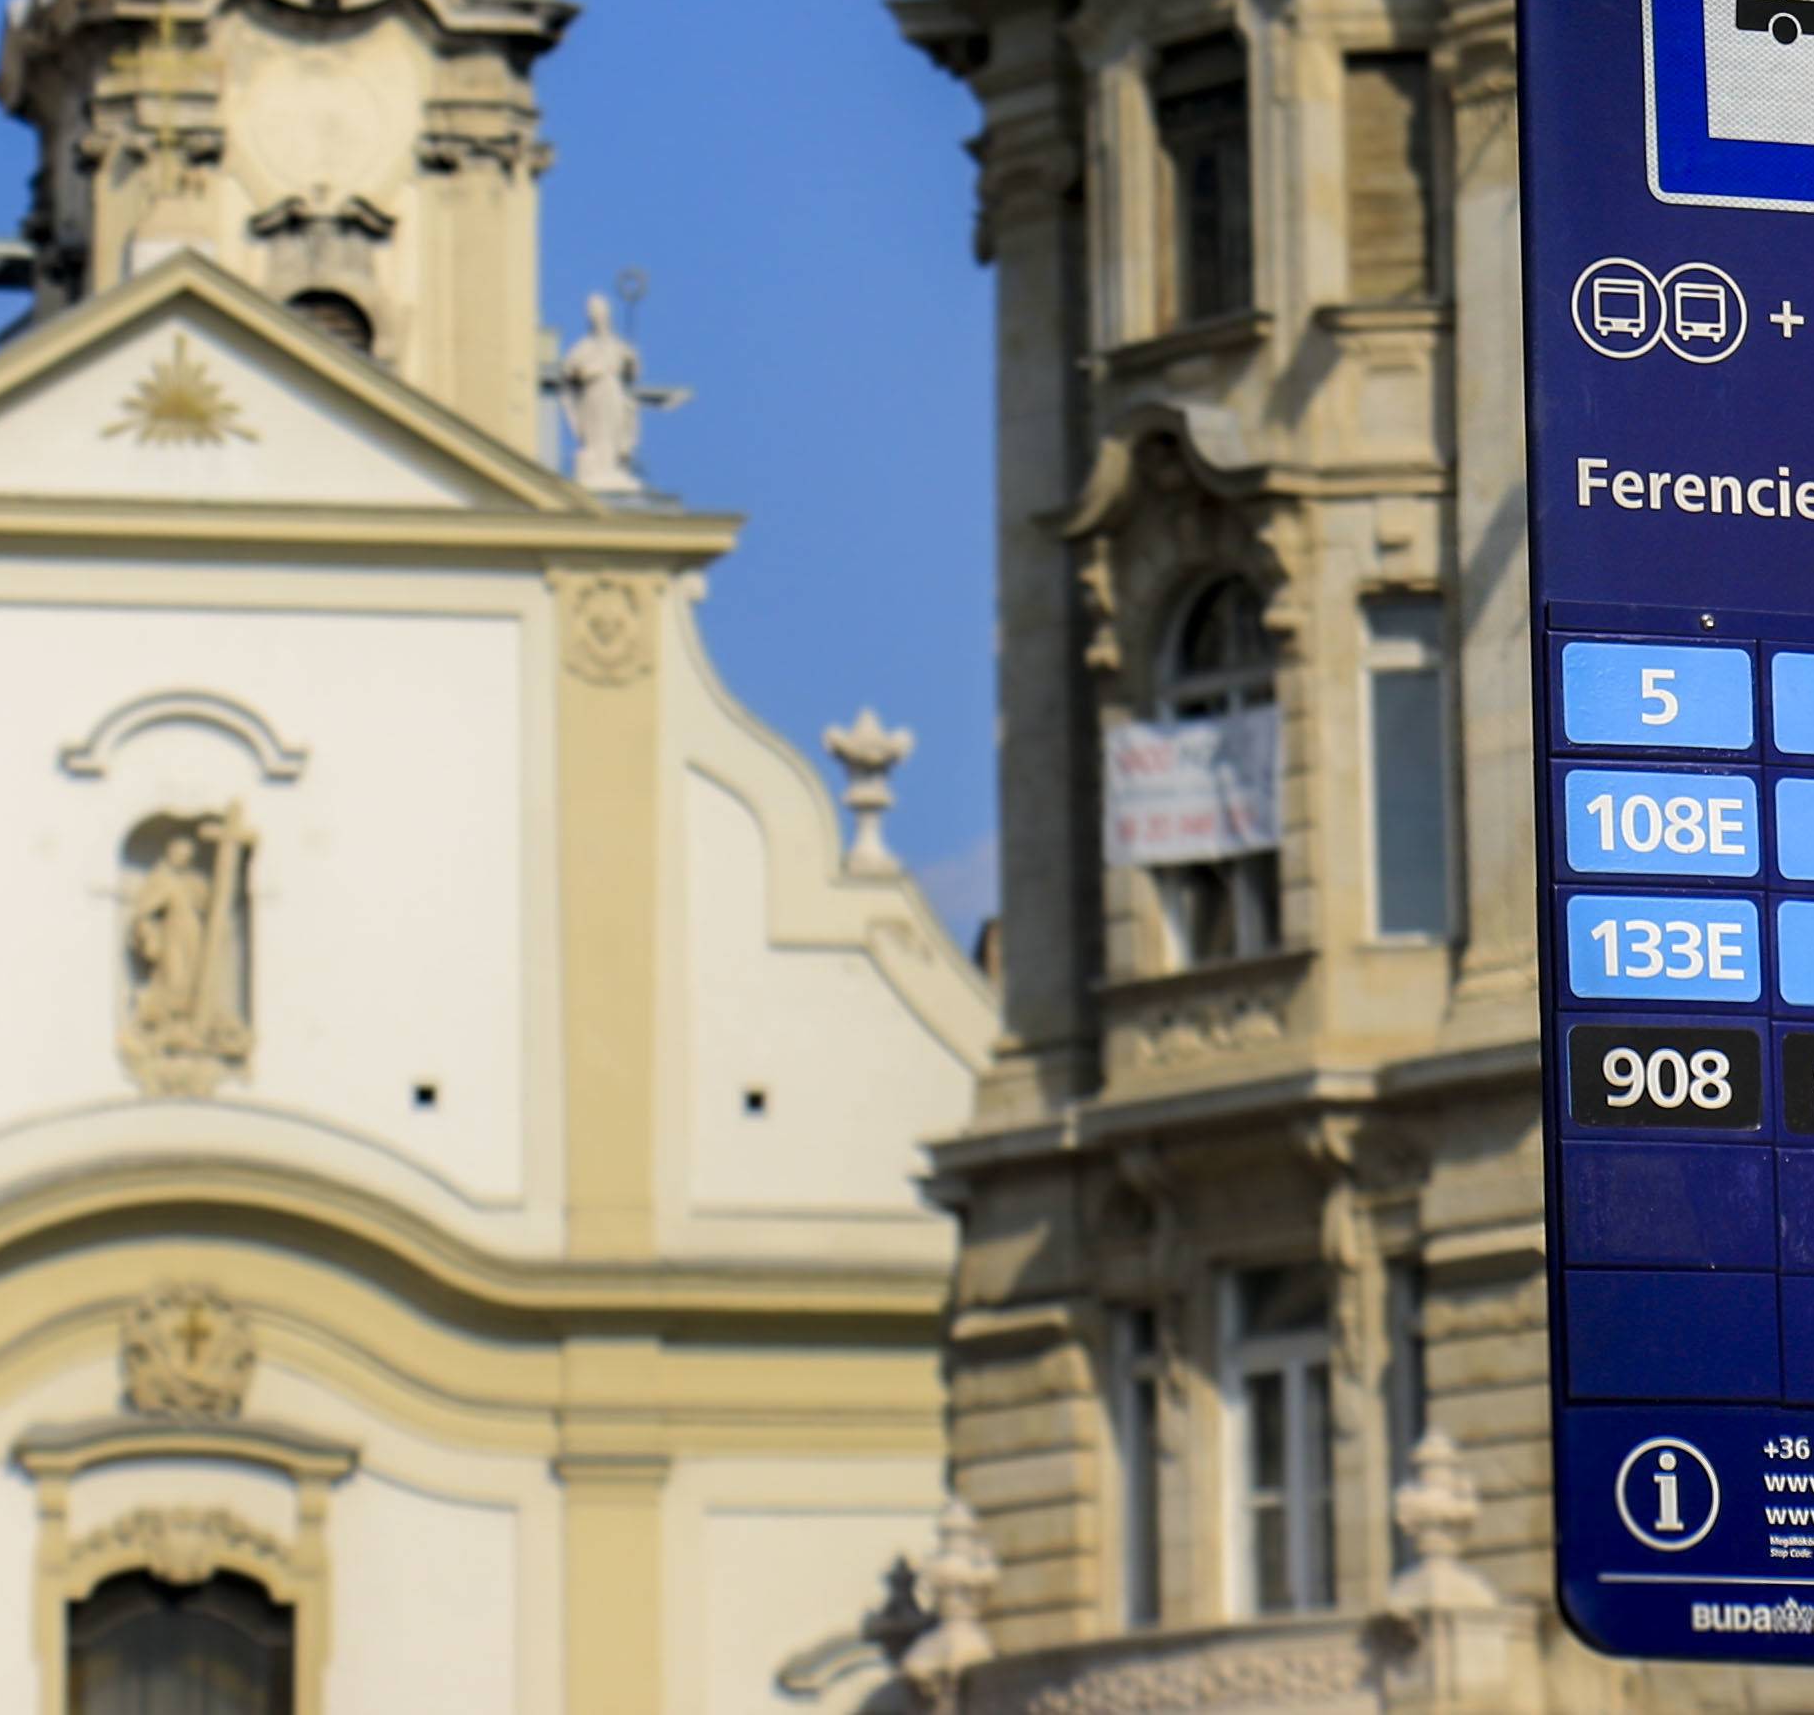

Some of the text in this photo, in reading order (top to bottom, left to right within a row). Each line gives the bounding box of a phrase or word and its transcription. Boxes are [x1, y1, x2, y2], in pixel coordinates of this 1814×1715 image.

[1641, 668, 1679, 725] 5
[1587, 794, 1746, 855] 108E
[1591, 920, 1745, 980] 133E
[1602, 1047, 1733, 1109] 908
[1763, 1436, 1811, 1460] +36
